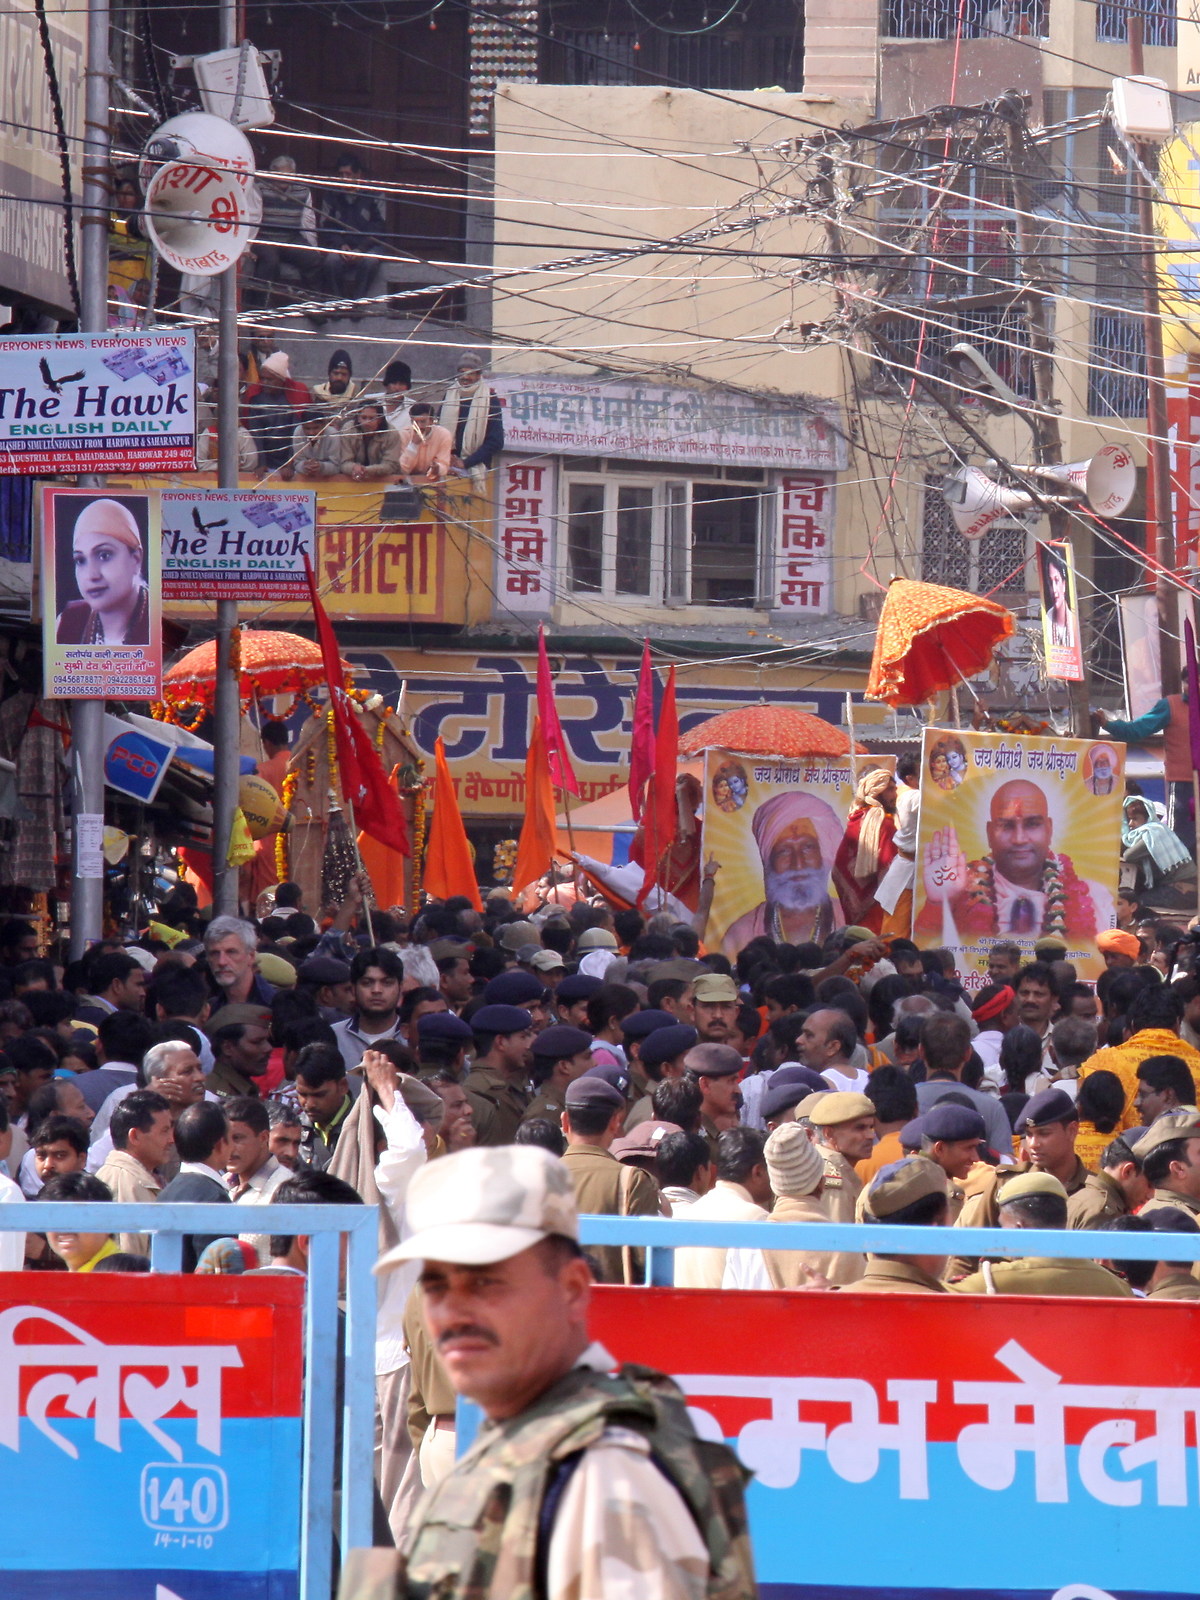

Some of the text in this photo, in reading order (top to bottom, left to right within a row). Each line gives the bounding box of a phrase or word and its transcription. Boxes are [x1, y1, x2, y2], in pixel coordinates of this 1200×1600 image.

[32, 202, 55, 272] FAST
[0, 336, 187, 351] VERYONE'S NEWS, EVERYONE'S VIEWS
[0, 383, 188, 419] The Hawk
[9, 420, 172, 436] ENGLISH DAILY
[27, 438, 82, 450] SIMULTANEOUSLY
[85, 437, 102, 448] FROM
[106, 437, 140, 448] HARDWAR
[147, 435, 190, 447] SAHARANPUR
[51, 452, 73, 461] AREA,
[75, 450, 126, 461] BAHADRABAD,
[128, 449, 162, 460] HARDWAR
[29, 464, 57, 473] 01334
[205, 493, 231, 502] NEWS,
[234, 493, 283, 502] EVERYONE'S
[285, 495, 309, 503] VIEWS
[218, 530, 310, 556] Hawk
[166, 559, 296, 568] ENGLISH DAILY
[111, 746, 159, 779] PCO
[974, 742, 1077, 780] जय श्रीराधे जय श्रीकृष्ण
[147, 1476, 218, 1524] 140
[154, 1531, 214, 1549] 14-1-10
